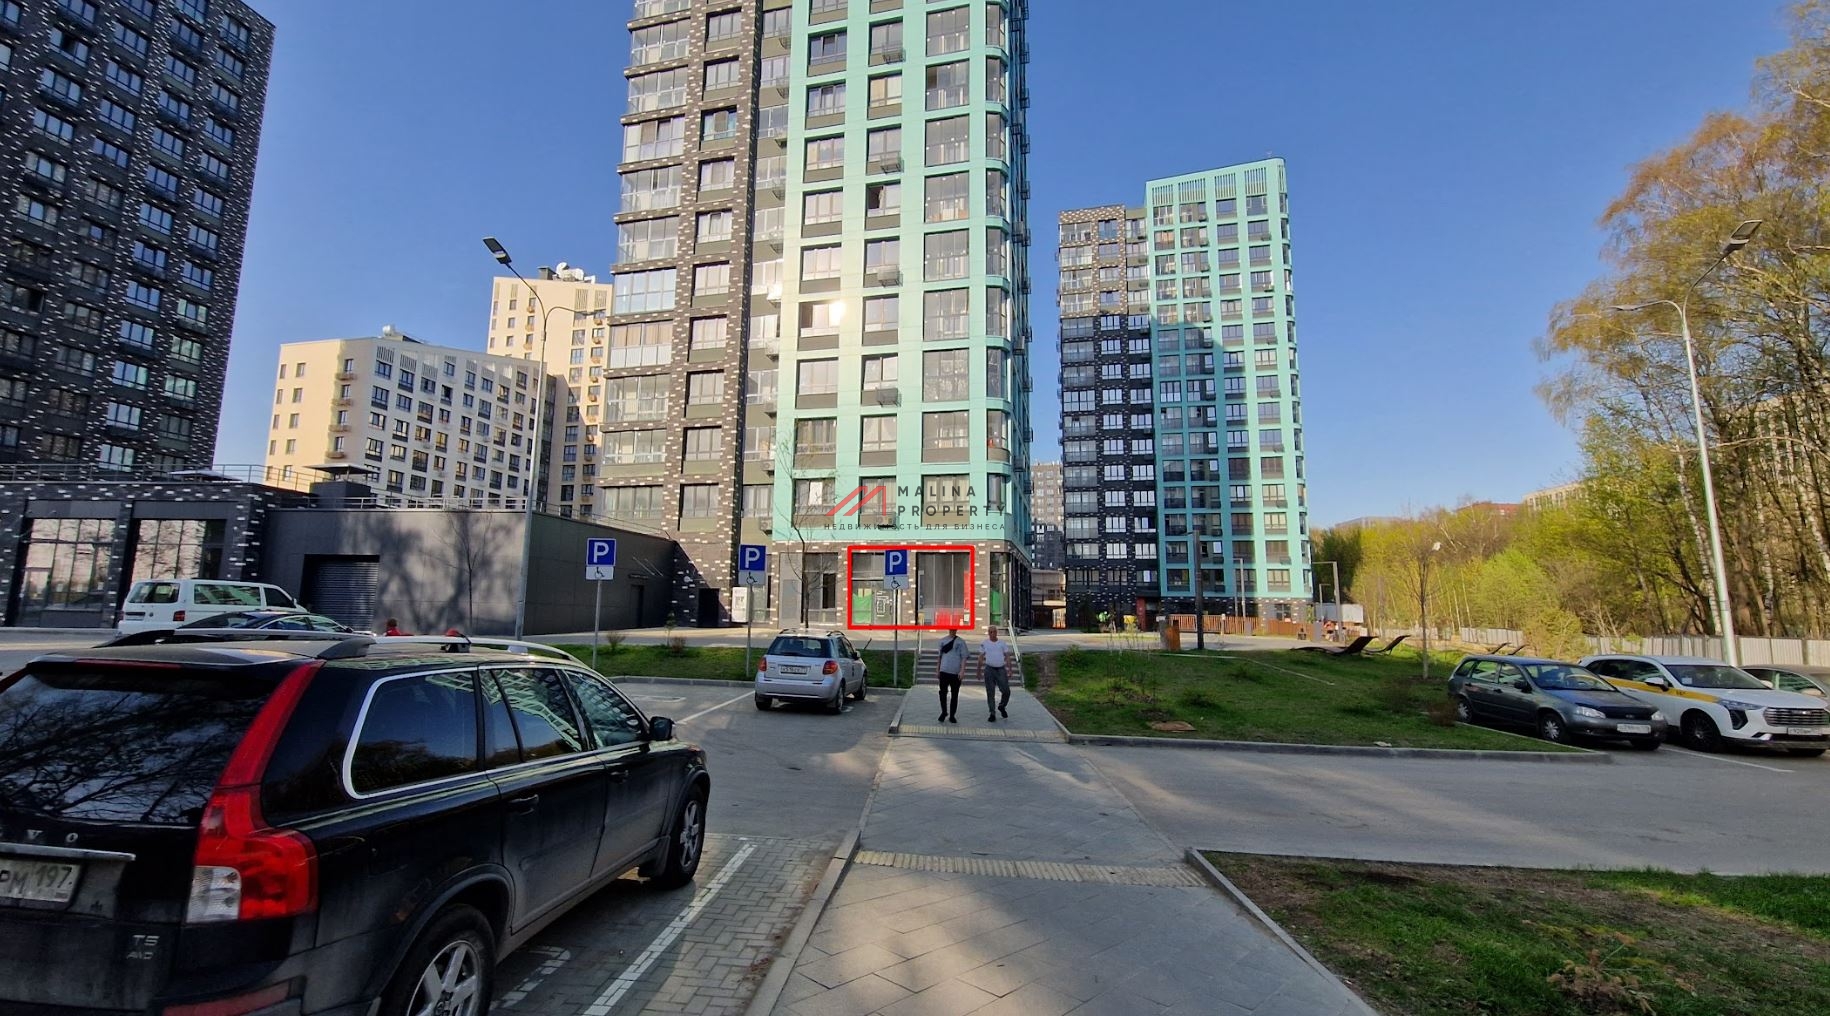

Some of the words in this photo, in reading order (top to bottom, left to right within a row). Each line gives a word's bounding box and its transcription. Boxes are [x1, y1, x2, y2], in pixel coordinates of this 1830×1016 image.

[593, 541, 609, 563] P
[745, 547, 760, 569] P
[889, 551, 903, 573] P
[0, 827, 79, 843] VO
